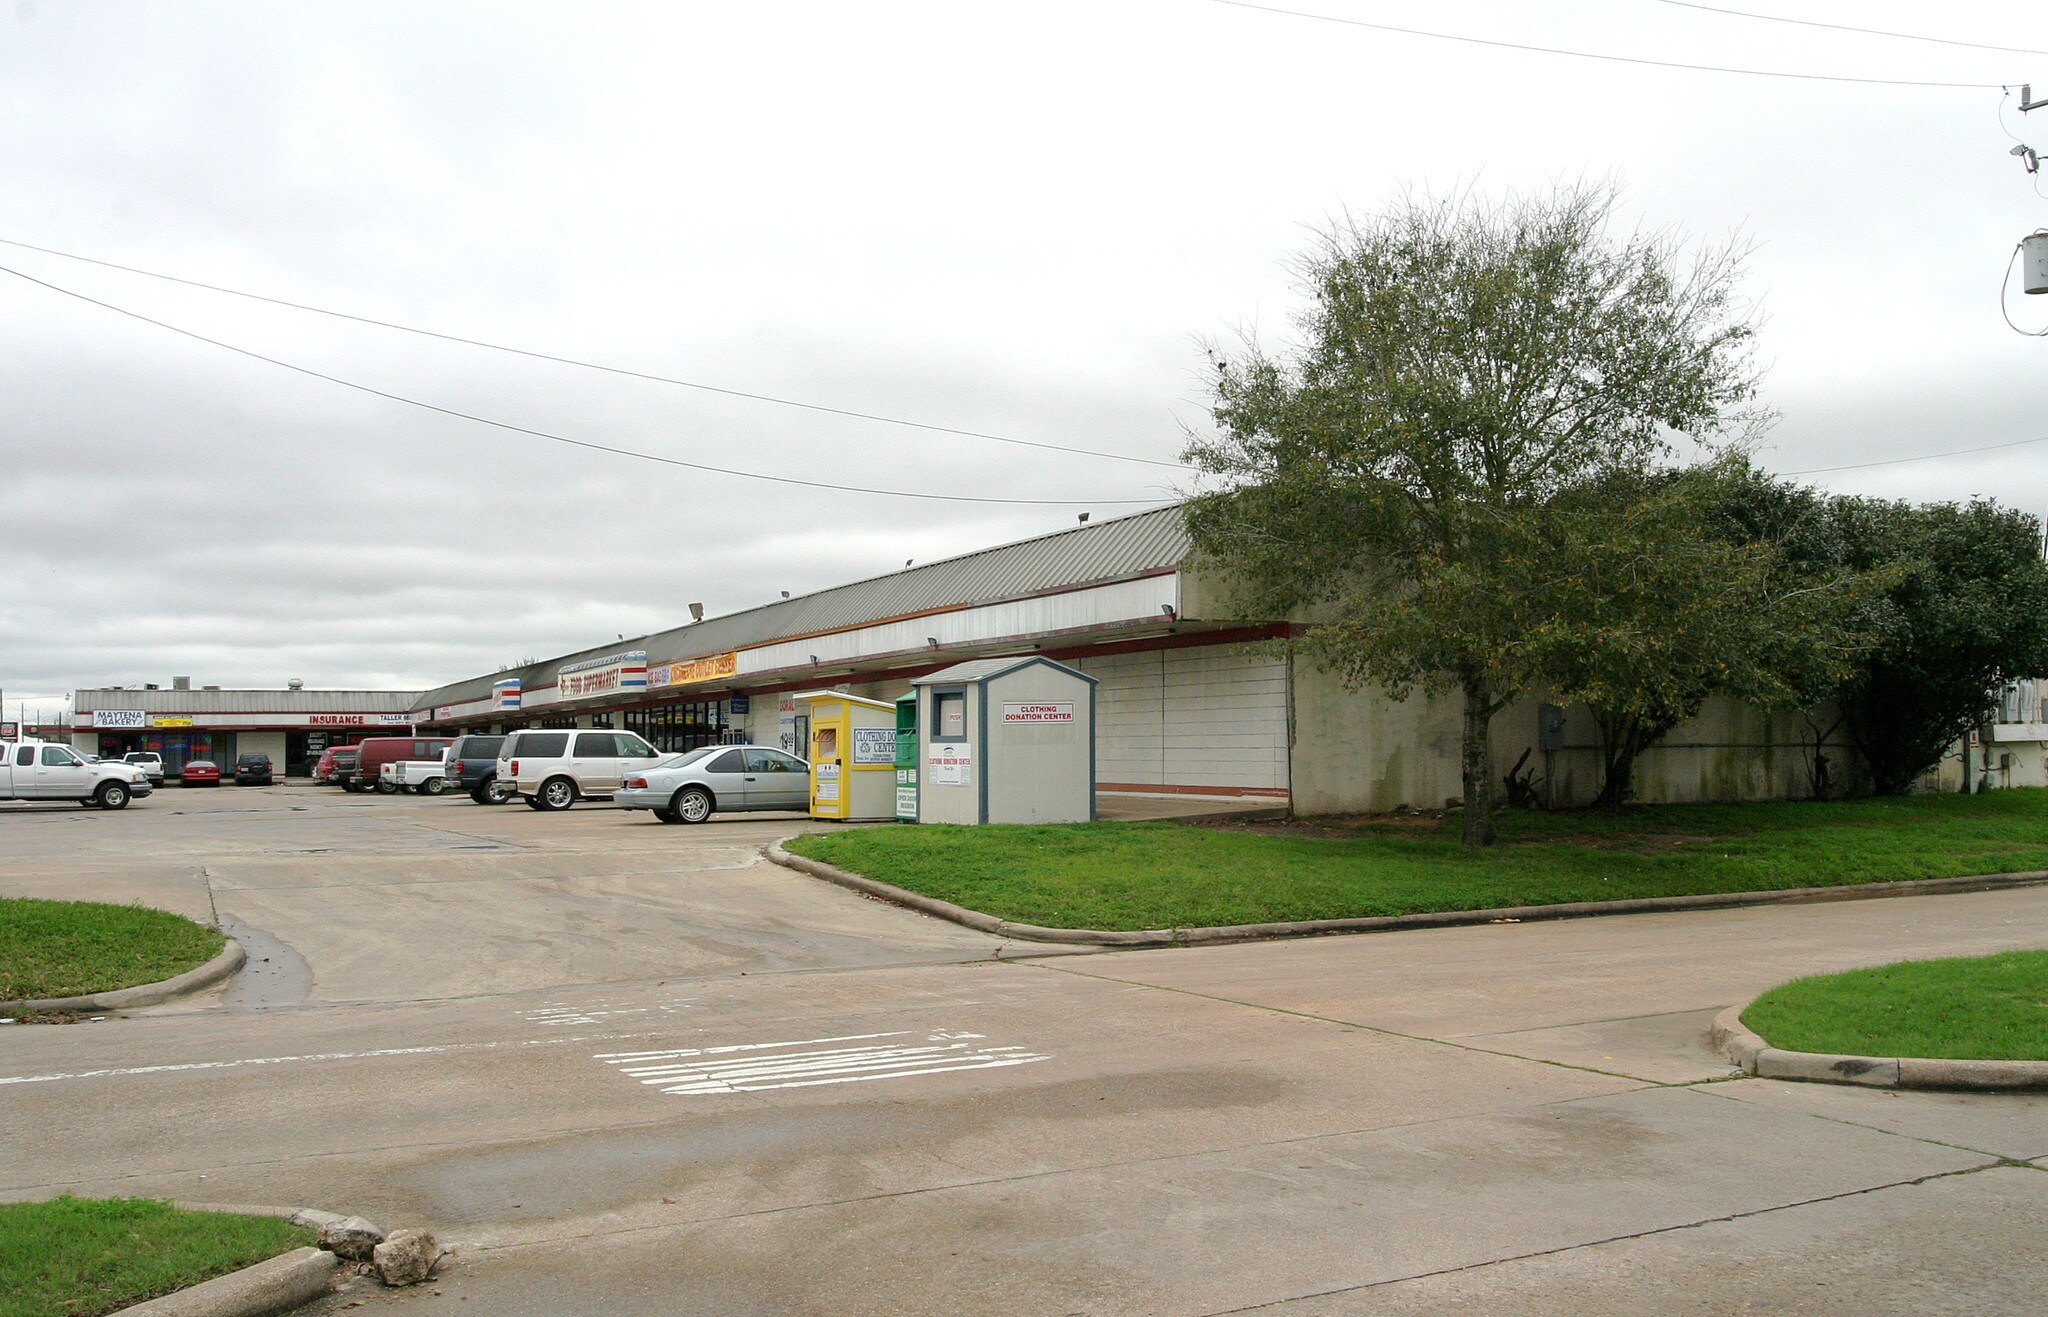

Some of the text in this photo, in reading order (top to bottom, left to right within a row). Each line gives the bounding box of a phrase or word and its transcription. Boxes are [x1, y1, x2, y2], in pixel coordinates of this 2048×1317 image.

[584, 668, 619, 694] SUPERMARKET
[97, 711, 143, 719] MAYTENA
[309, 715, 364, 724] INSURANCE
[1005, 713, 1041, 721] DONATION
[102, 718, 137, 726] BAKERY
[856, 731, 886, 742] CLOTHING
[873, 742, 896, 753] CENTE
